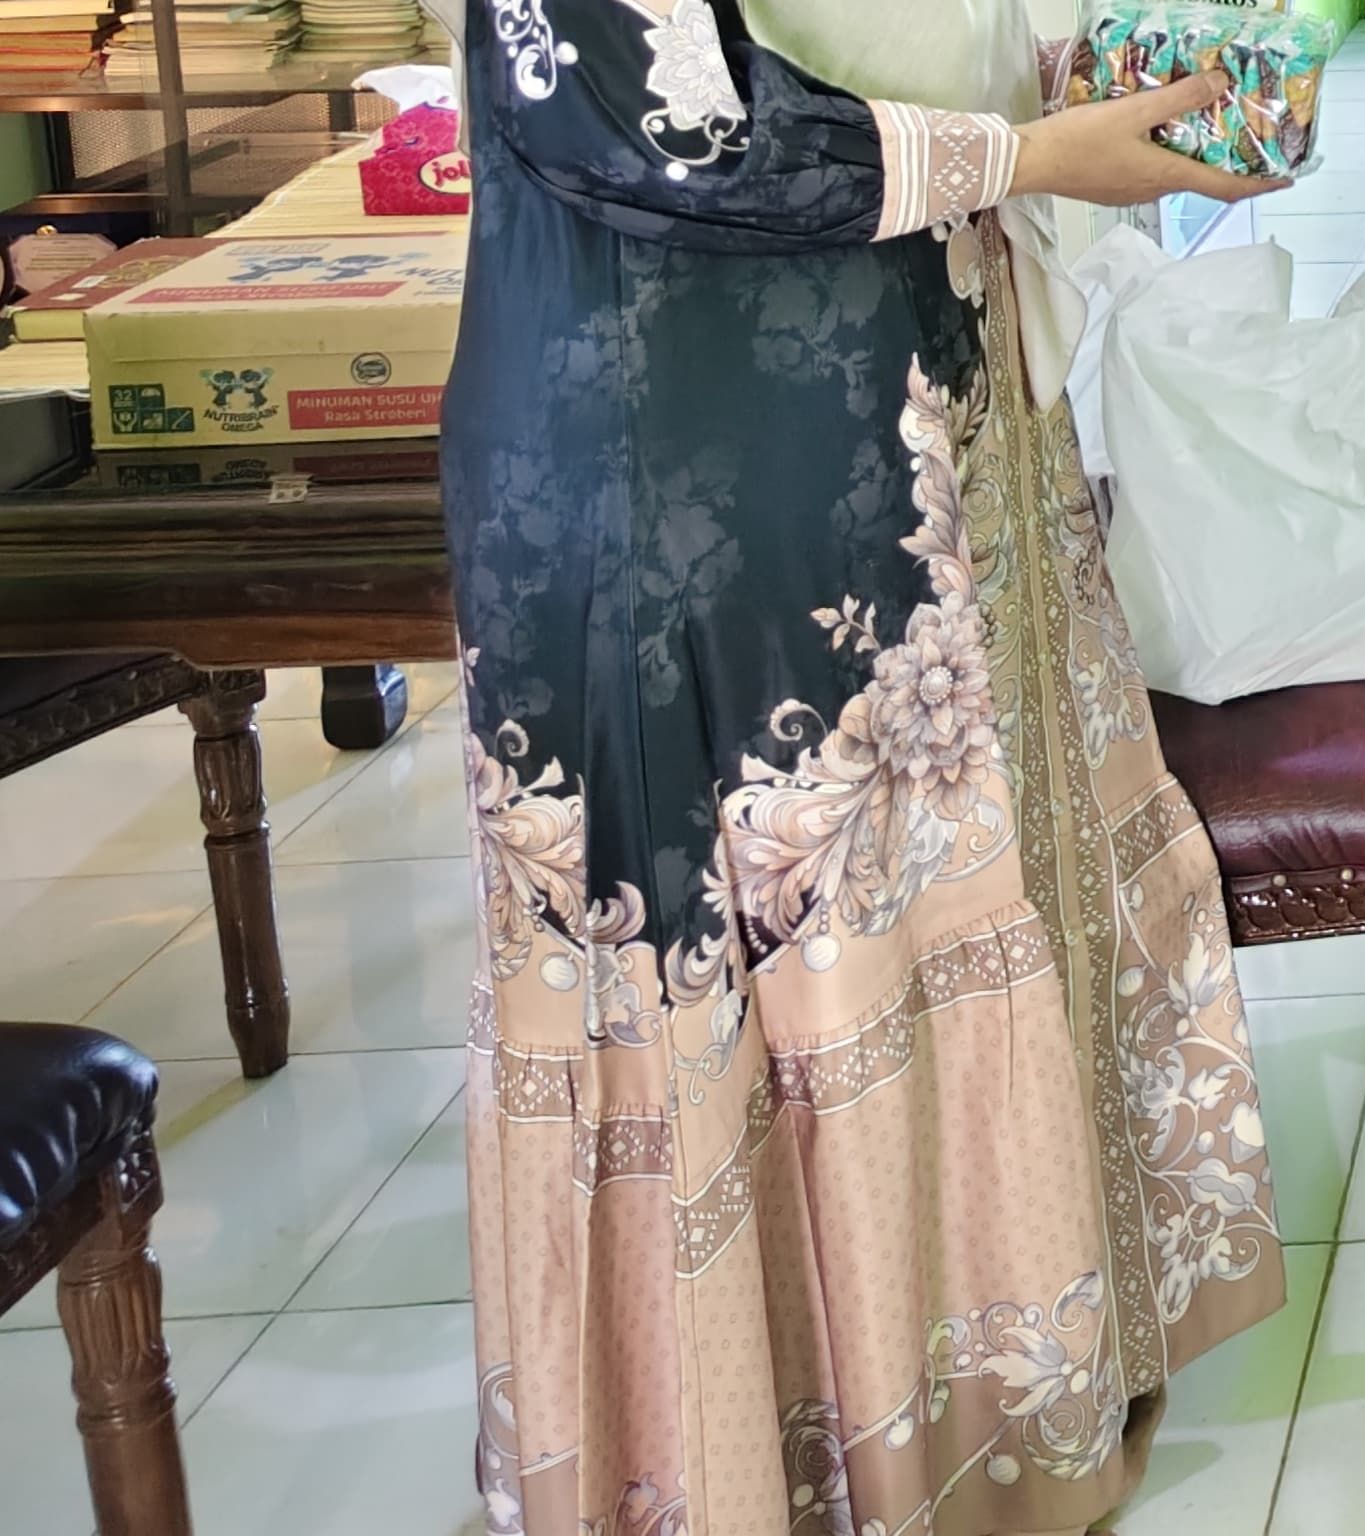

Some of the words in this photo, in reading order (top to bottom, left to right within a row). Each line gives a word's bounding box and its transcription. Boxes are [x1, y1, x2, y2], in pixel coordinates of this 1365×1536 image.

[113, 389, 133, 401] 32
[296, 395, 371, 409] MINUMAN
[377, 393, 415, 405] SUSU
[325, 411, 361, 422] Rasa
[366, 409, 427, 421] Stroberi
